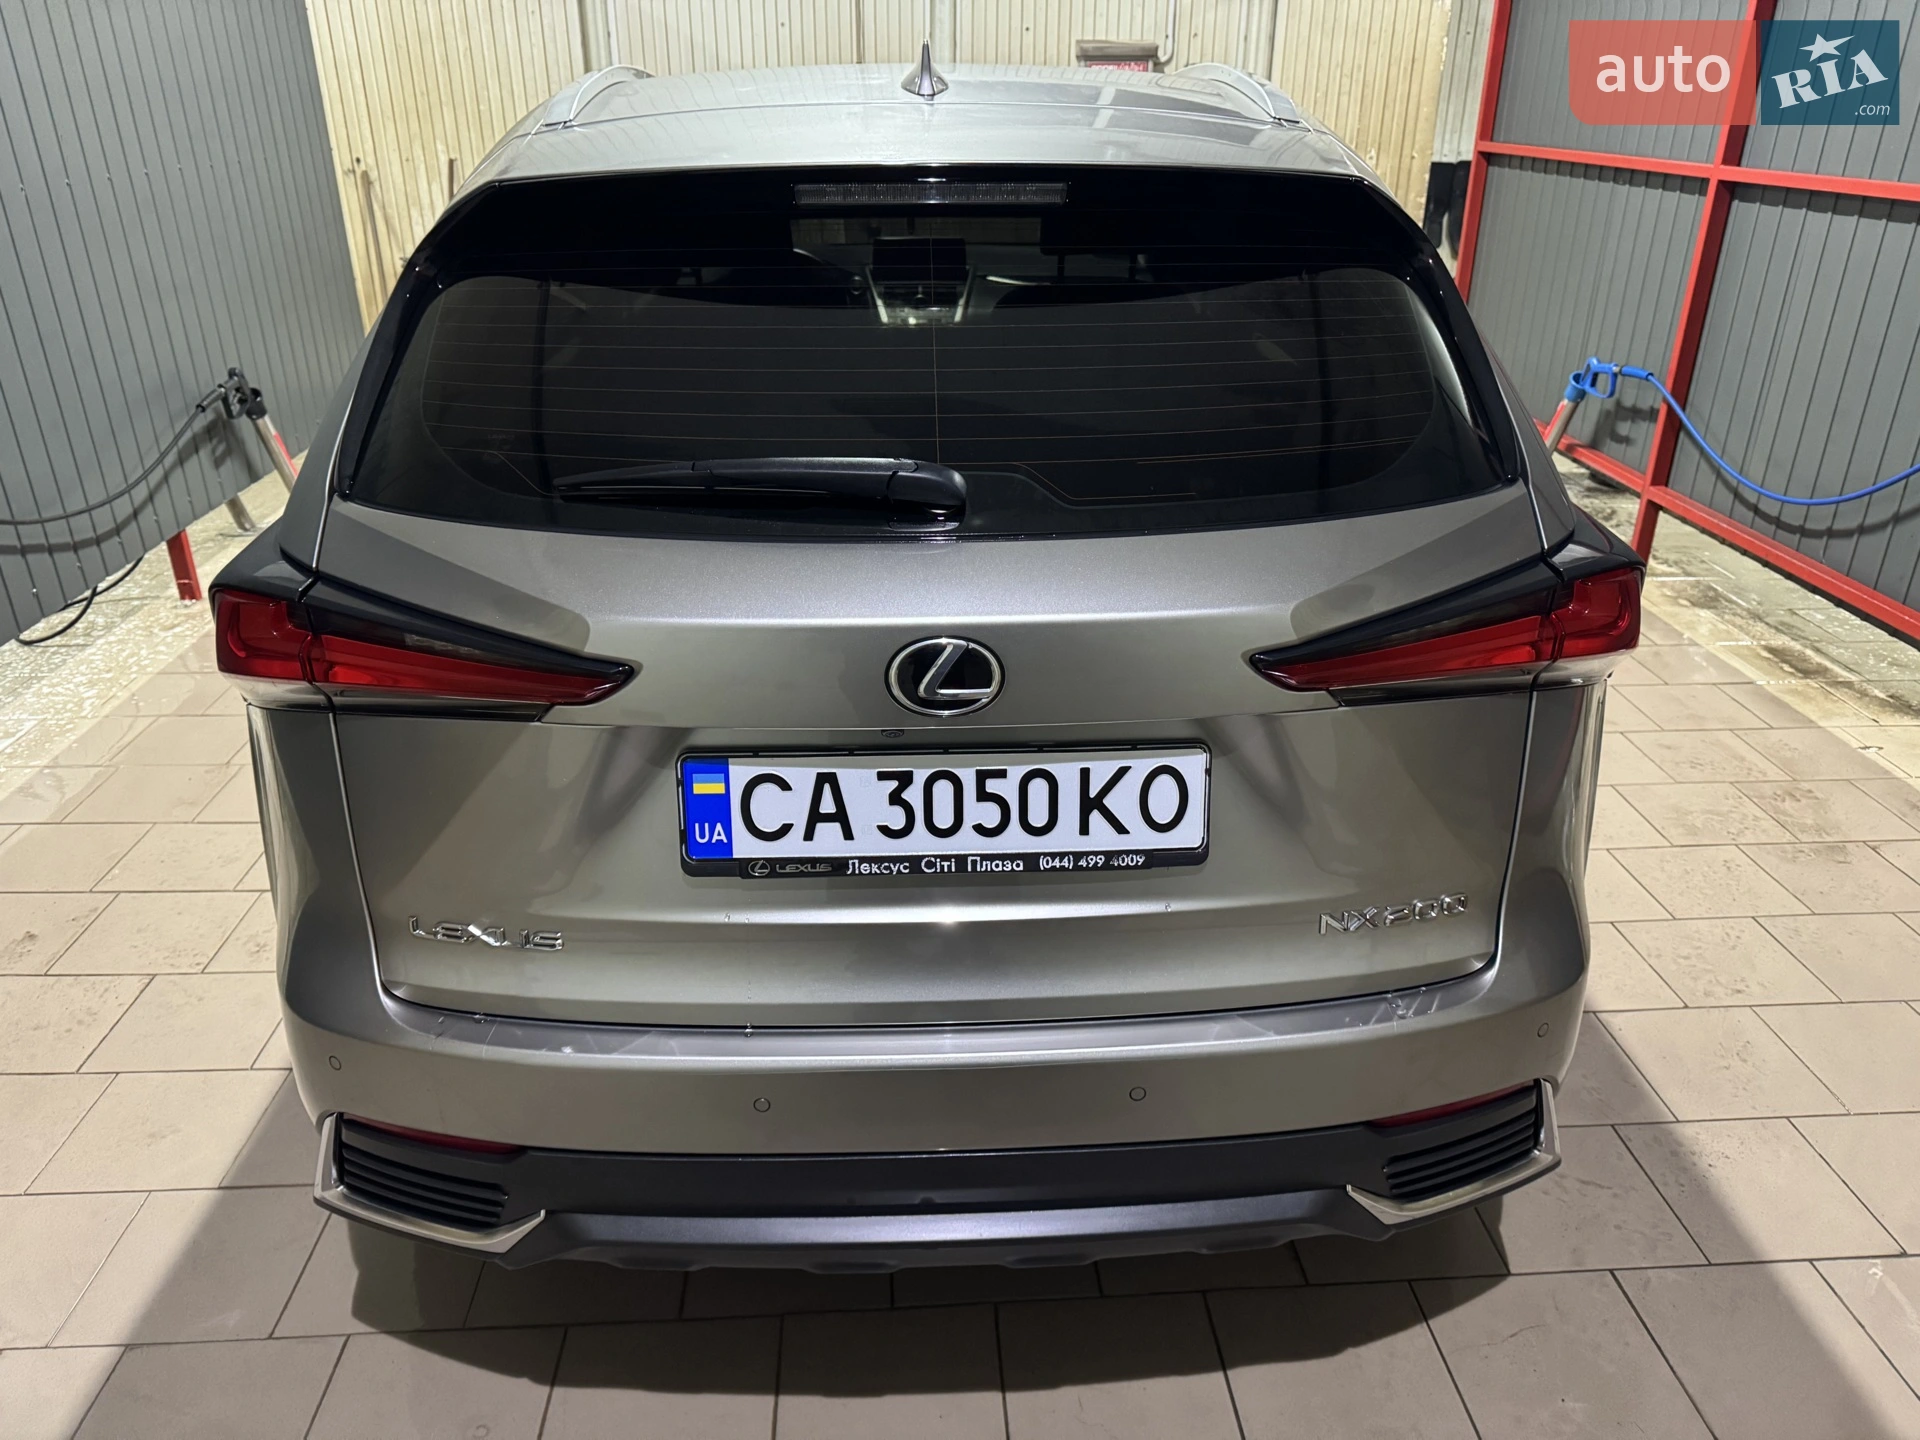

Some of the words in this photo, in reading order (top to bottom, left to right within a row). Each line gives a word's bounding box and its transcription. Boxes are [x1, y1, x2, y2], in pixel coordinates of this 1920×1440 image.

[740, 771, 855, 842] CA
[876, 768, 1059, 840] 3050
[1079, 764, 1189, 836] KO
[694, 823, 728, 844] UA
[776, 863, 833, 873] LEXUS
[846, 859, 910, 875] Лексус
[920, 857, 956, 873] Сіті
[967, 856, 1024, 872] Плаза
[1039, 855, 1074, 870] (044)
[1077, 854, 1105, 868] 499
[1109, 853, 1146, 867] 4009
[408, 915, 565, 951] LEXUS
